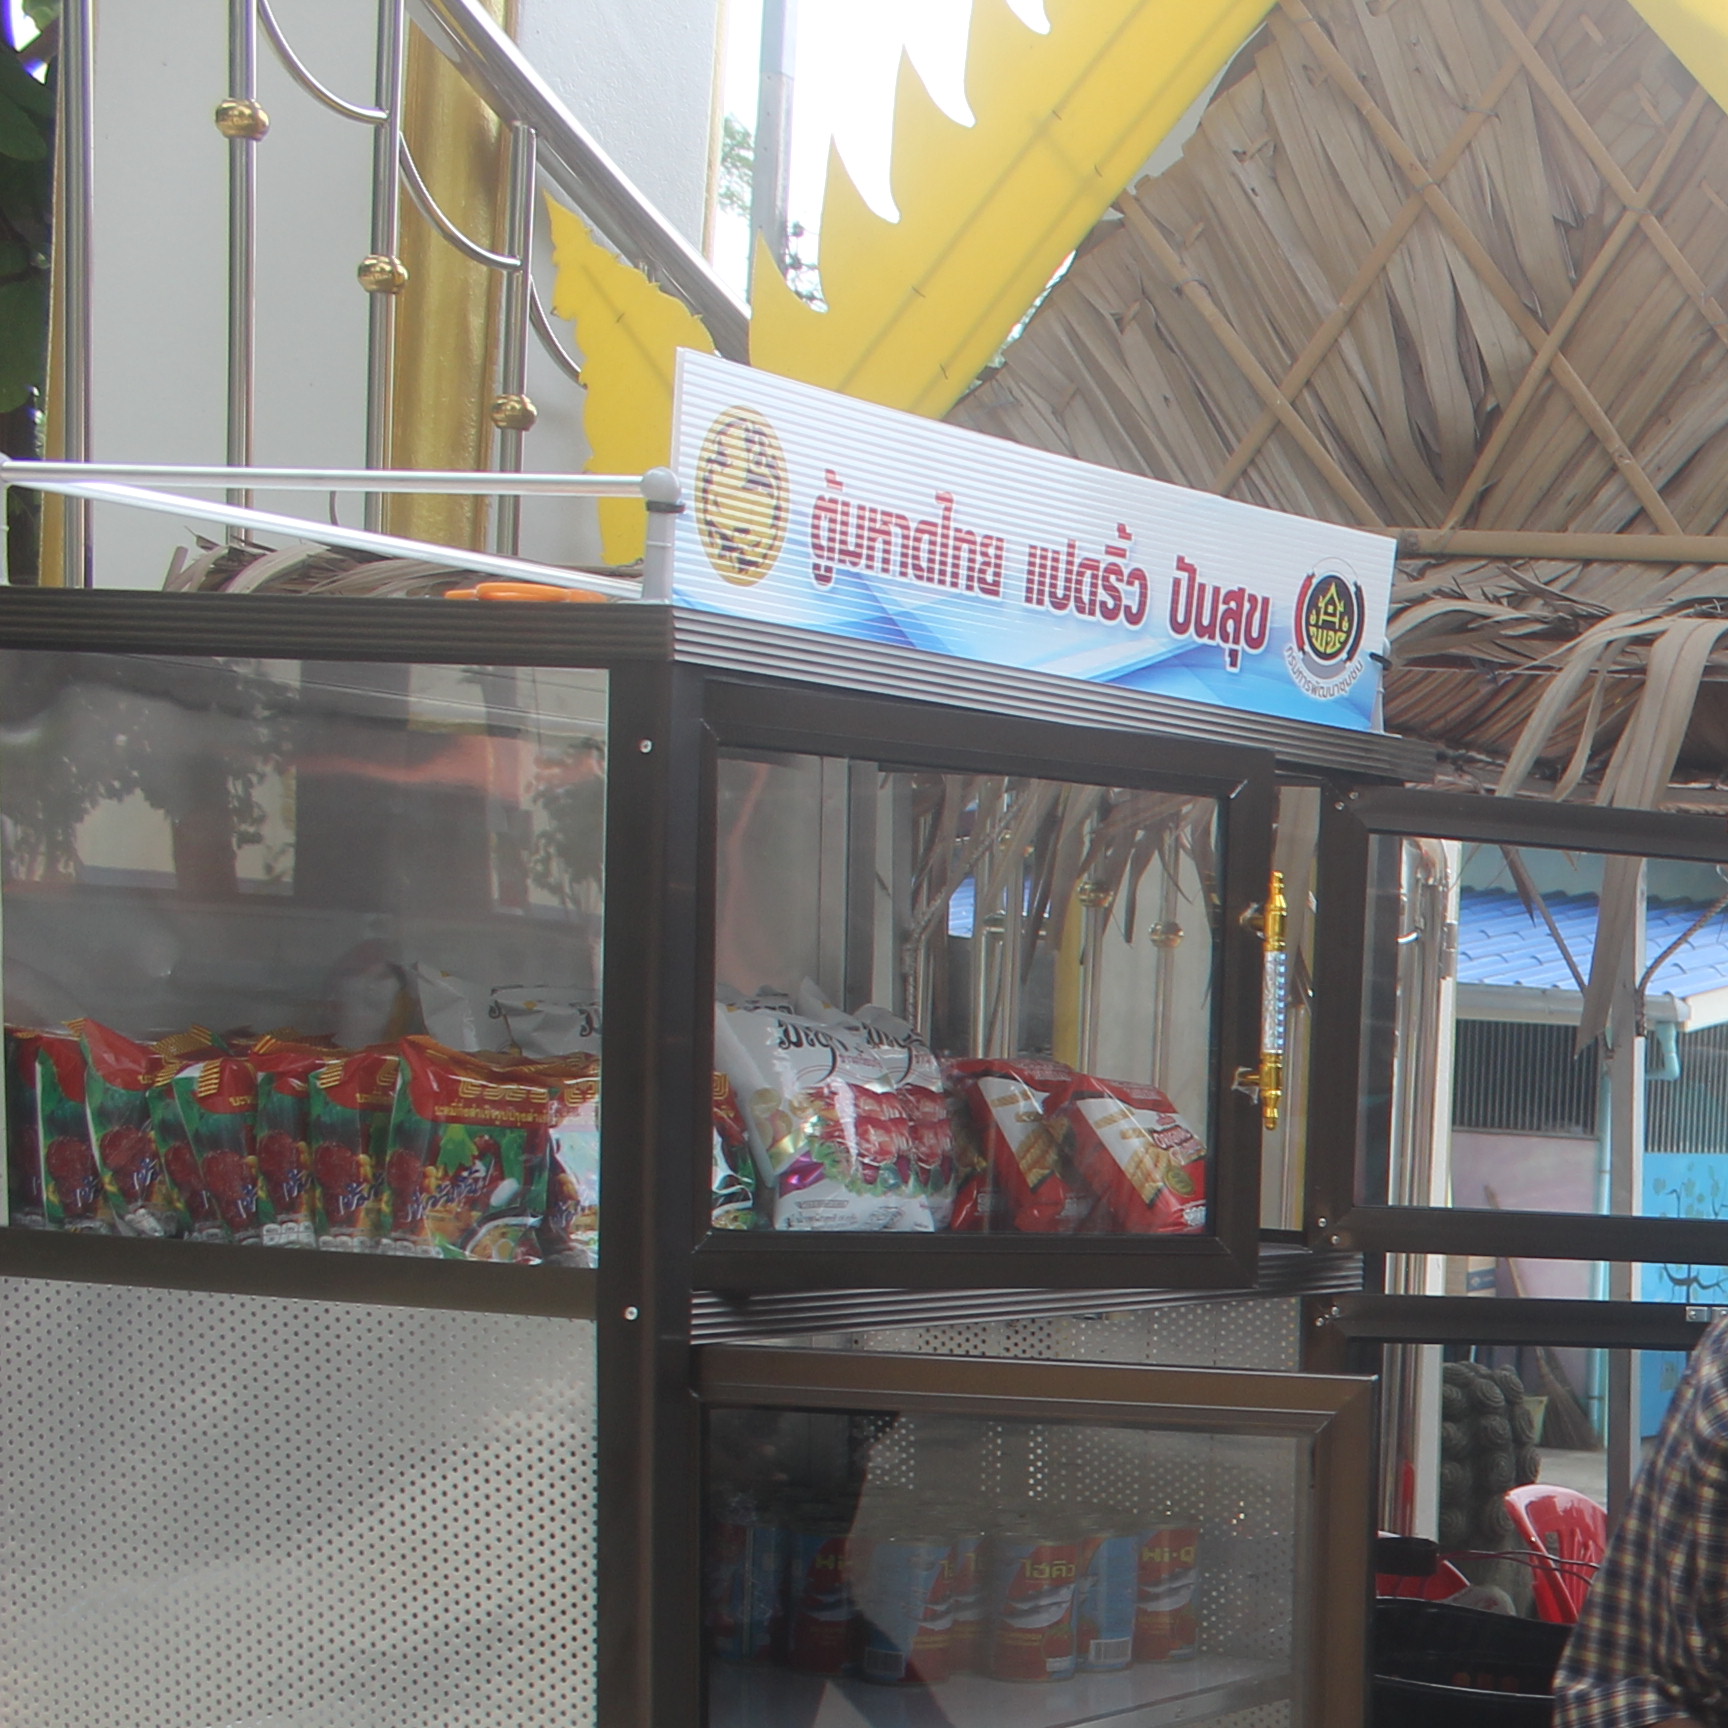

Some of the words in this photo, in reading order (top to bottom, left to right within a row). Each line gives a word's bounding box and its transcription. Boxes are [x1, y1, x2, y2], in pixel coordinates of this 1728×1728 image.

[811, 468, 1004, 597] ตู้มหาดไทย
[1025, 522, 1147, 626] แปดริ้ว
[1170, 555, 1271, 668] ปันสุข
